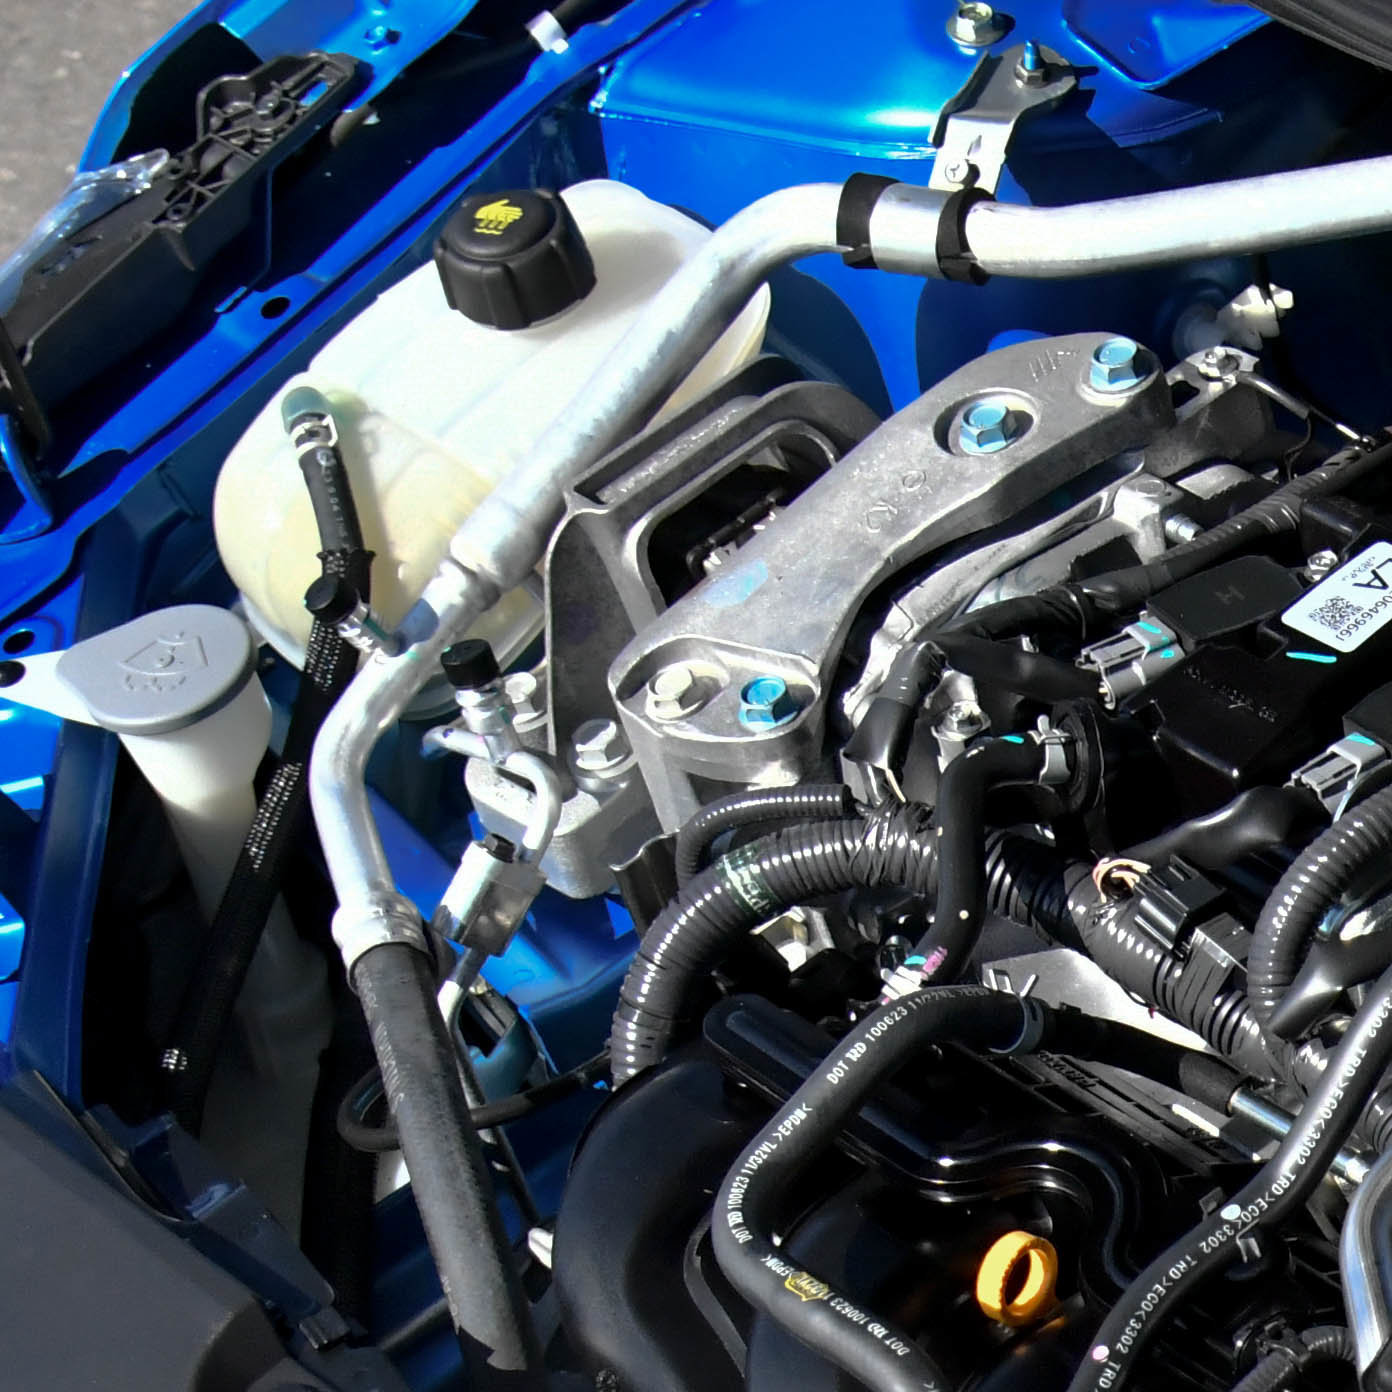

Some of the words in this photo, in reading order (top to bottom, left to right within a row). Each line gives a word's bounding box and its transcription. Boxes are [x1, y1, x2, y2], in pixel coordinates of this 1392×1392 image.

[864, 1005, 909, 1043] 100623
[826, 1059, 850, 1085] DOT
[727, 1176, 750, 1210] 100623
[731, 1226, 754, 1245] DOT
[829, 1297, 871, 1325] 100623
[884, 1336, 911, 1357] DOT
